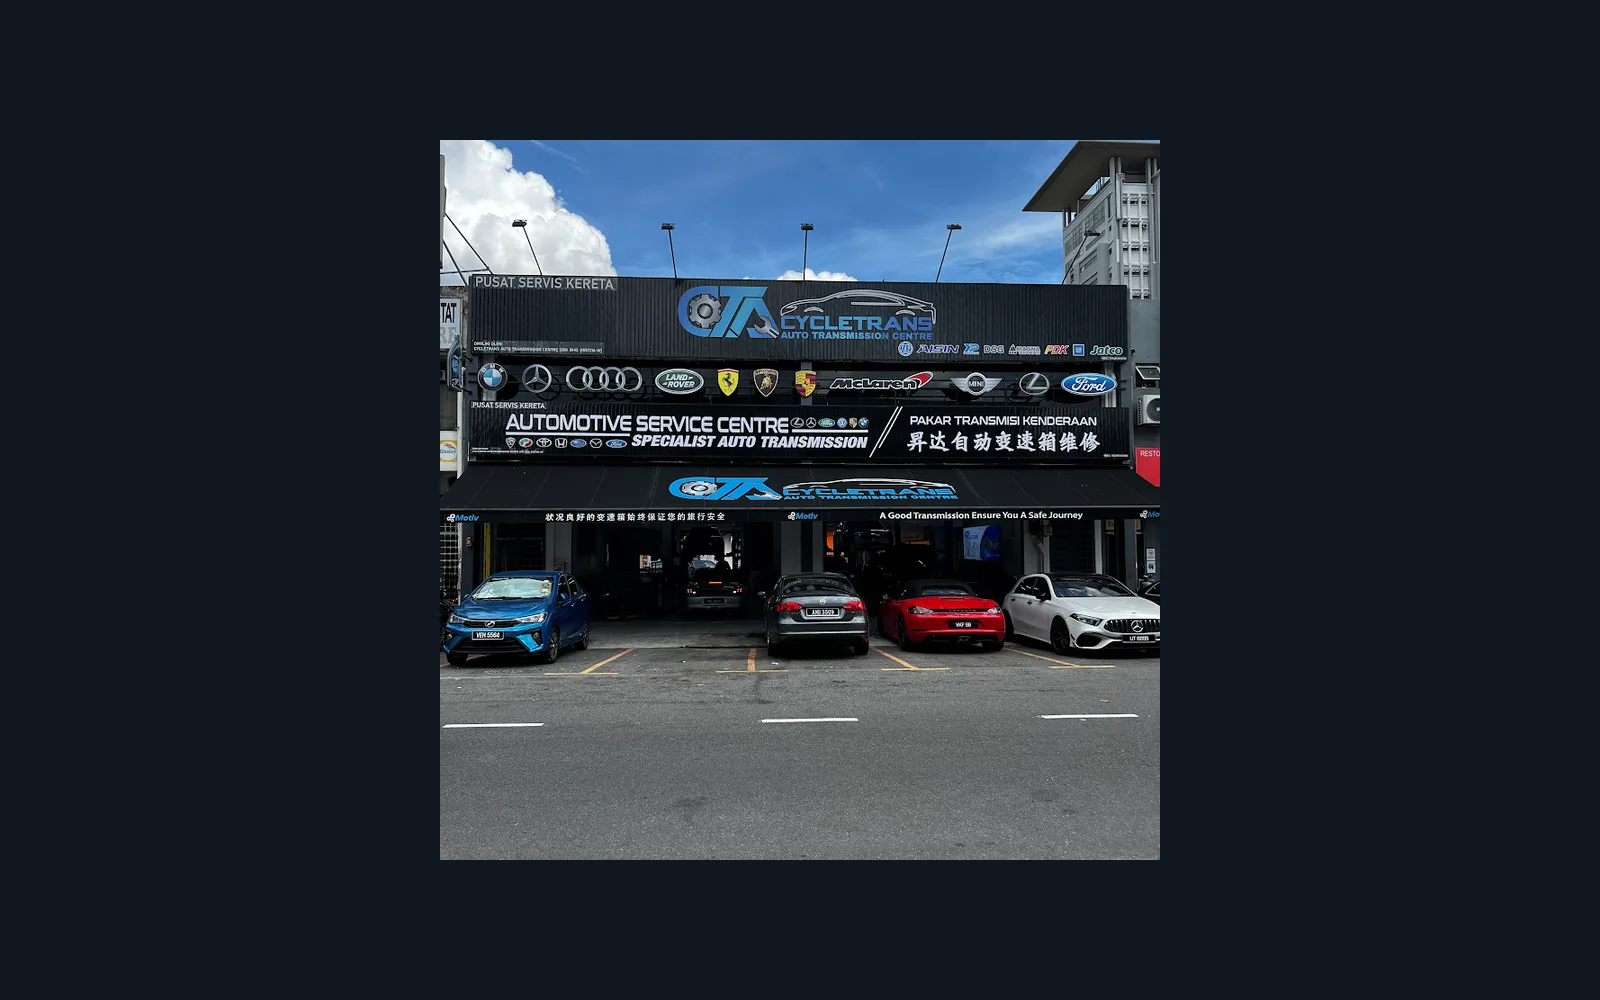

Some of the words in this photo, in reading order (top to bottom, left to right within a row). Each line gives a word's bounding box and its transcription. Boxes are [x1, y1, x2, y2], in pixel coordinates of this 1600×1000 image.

[475, 276, 516, 288] PUSAT
[518, 277, 562, 289] SERVIS
[566, 278, 614, 290] KERETA
[781, 315, 933, 331] CYCLETRANS
[781, 331, 809, 340] AUTO
[812, 331, 889, 340] TRANSMISSION
[892, 332, 933, 341] CENTRE
[917, 344, 960, 354] AISIN
[983, 344, 1005, 354] DSG
[1044, 344, 1070, 355] PDK
[1090, 344, 1124, 356] Jatco
[829, 377, 921, 390] McLaren
[968, 380, 984, 388] MINI
[1071, 378, 1107, 393] Ford
[472, 401, 494, 409] PUSAT
[519, 402, 545, 410] KERETA
[505, 413, 632, 432] AUTOMOTIVE
[636, 415, 713, 433] SERVICE
[717, 416, 789, 434] CENTRE
[909, 415, 951, 426] PAKAR
[953, 415, 1020, 426] TRANSMISI
[1022, 416, 1098, 426] KENDERAAN
[631, 434, 716, 448] SPECIALIST
[717, 435, 757, 448] AUTO
[760, 435, 869, 449] TRANSMISSION
[906, 430, 1101, 453] 昇达自动变速箱维修
[782, 487, 956, 496] CYCLETRANS
[455, 514, 480, 522] Motiv
[544, 512, 726, 522] 状况良好的变速箱始终保证您的旅行安全
[795, 512, 819, 520] Motiv
[879, 511, 886, 519] A
[887, 511, 912, 520] Good
[913, 511, 970, 520] Transmission
[971, 511, 1001, 519] Ensure
[1002, 511, 1019, 519] You
[1020, 511, 1027, 519] A
[1028, 511, 1047, 519] Safe
[1048, 511, 1083, 521] Journey
